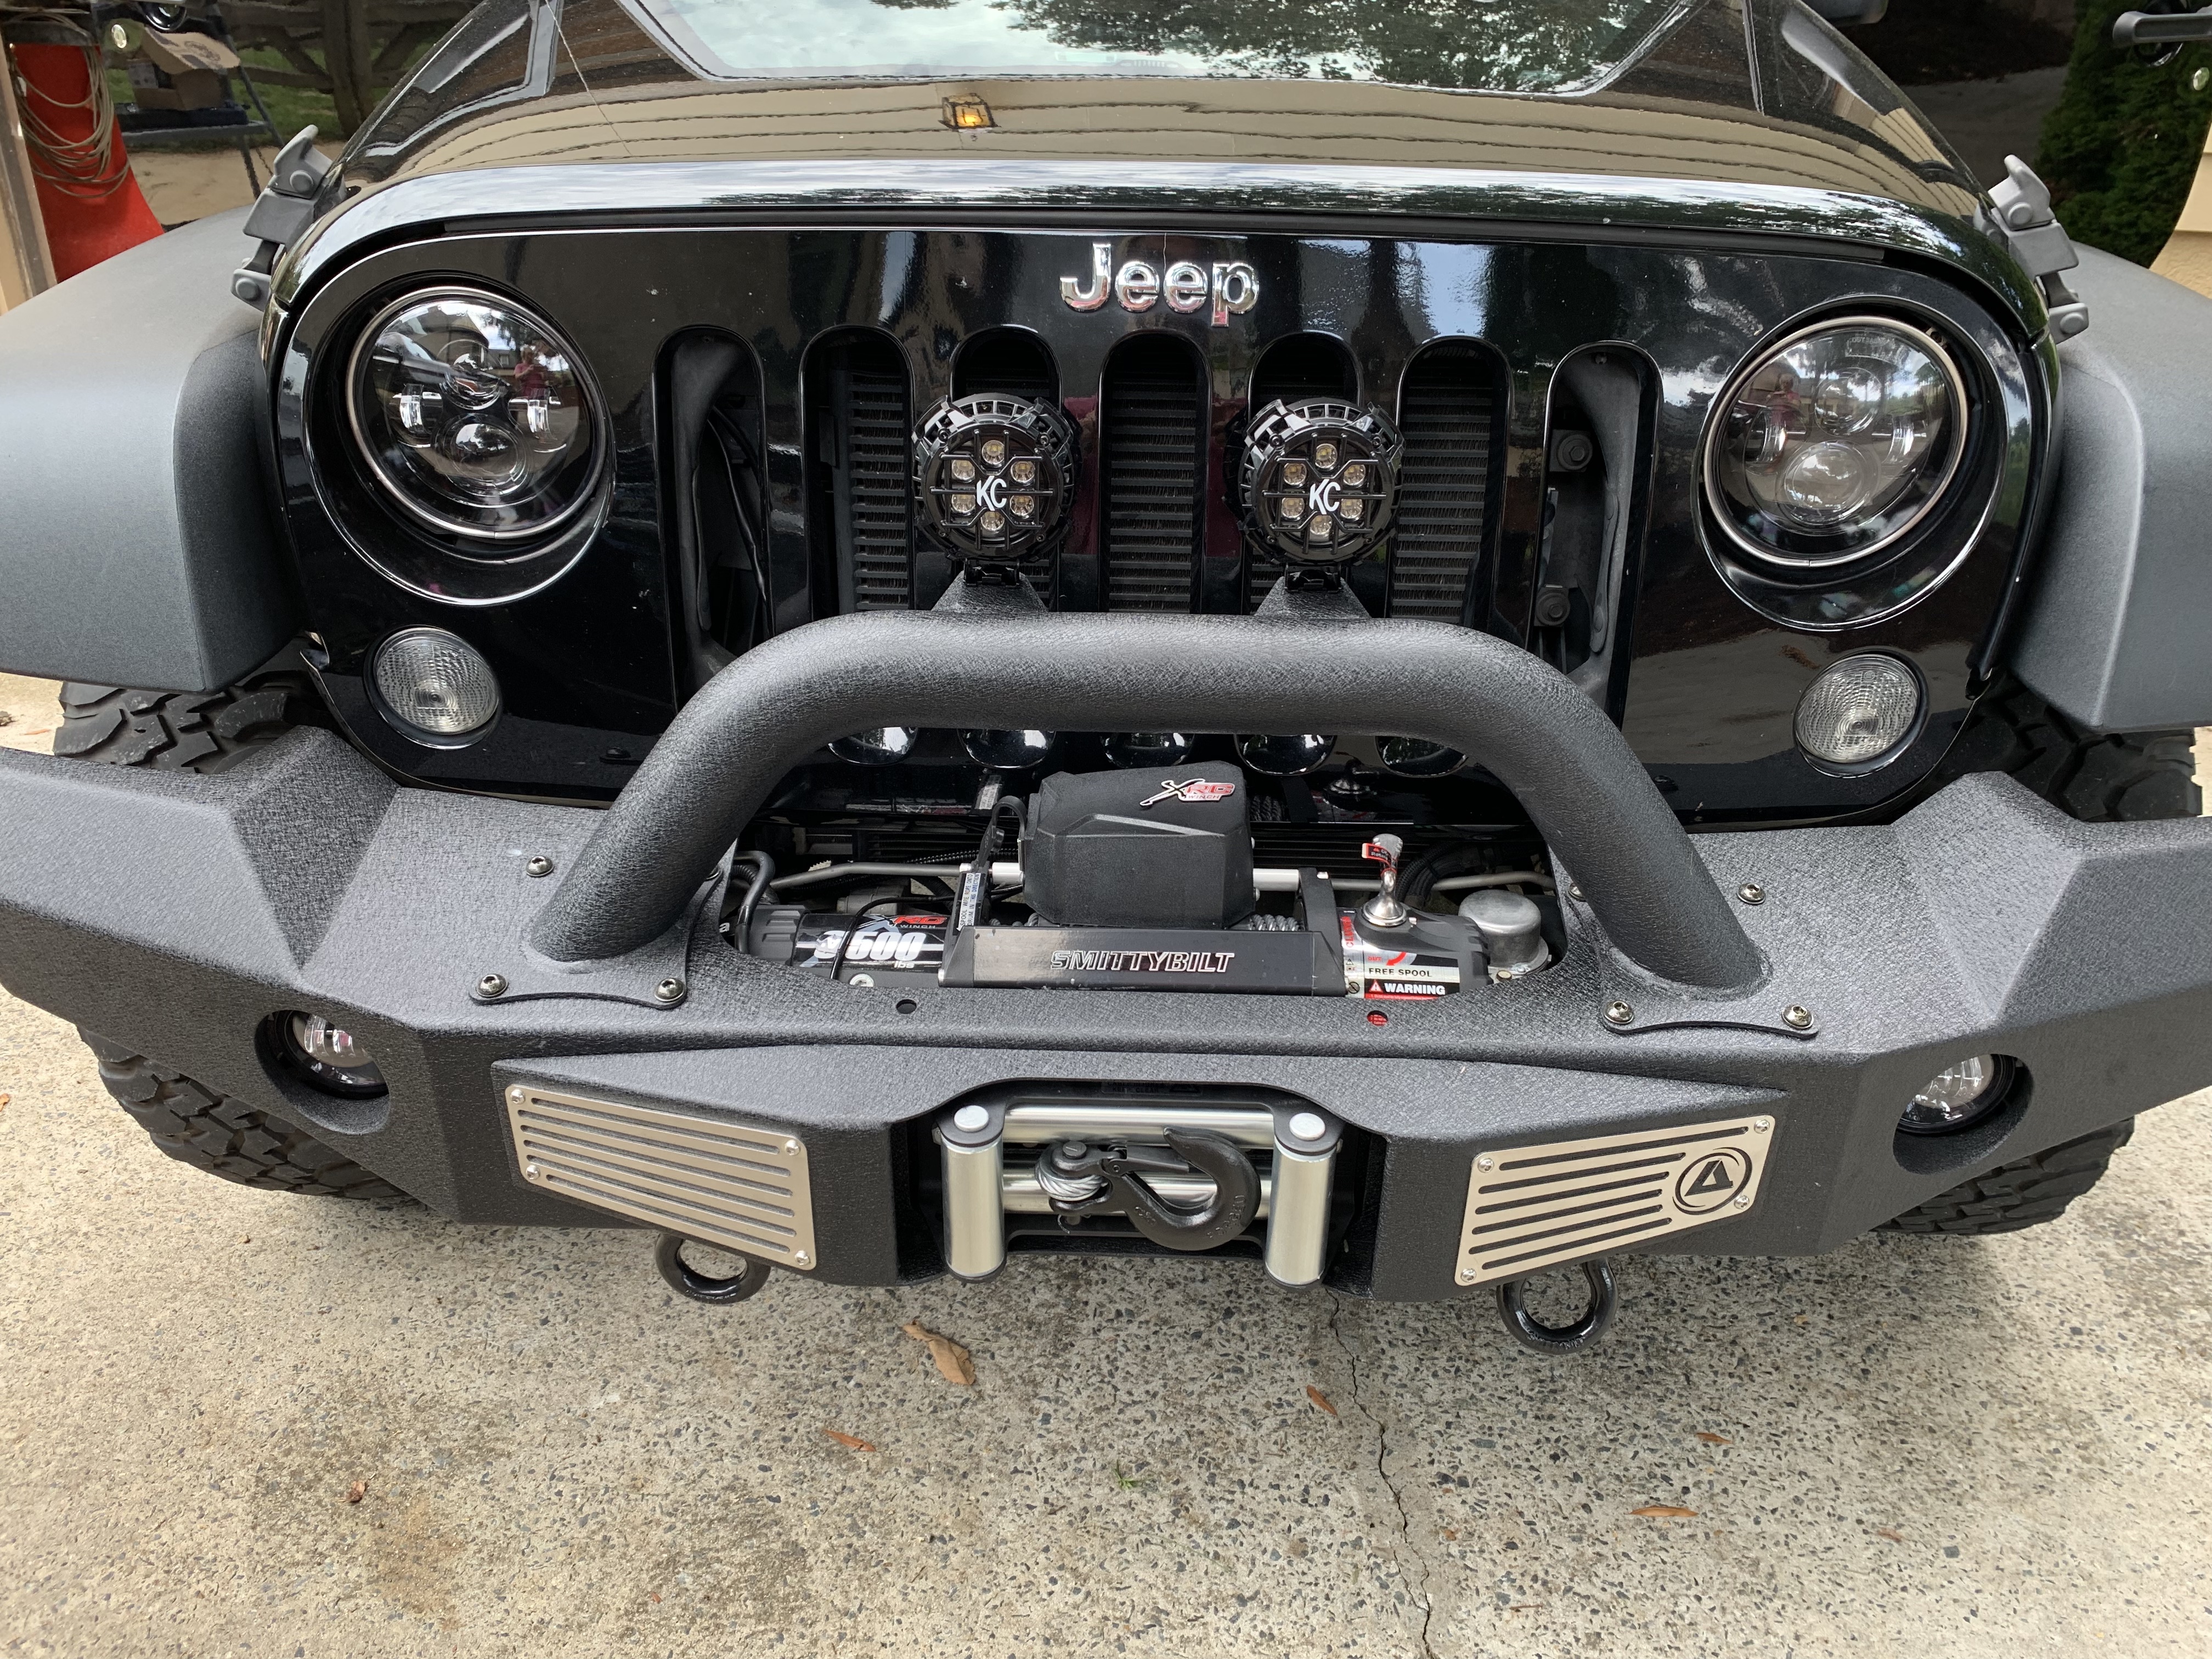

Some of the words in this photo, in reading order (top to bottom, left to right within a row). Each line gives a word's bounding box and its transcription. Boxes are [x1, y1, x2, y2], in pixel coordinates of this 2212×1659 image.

[1059, 241, 1260, 328] Jeep
[976, 475, 1008, 511] KC
[1308, 478, 1340, 516] KC
[972, 874, 980, 892] DIRECTION
[1050, 950, 1235, 973] SMITTYBILT
[1368, 967, 1395, 975] FREE
[1398, 969, 1433, 977] SPOOL
[1384, 983, 1446, 995] WARNING
